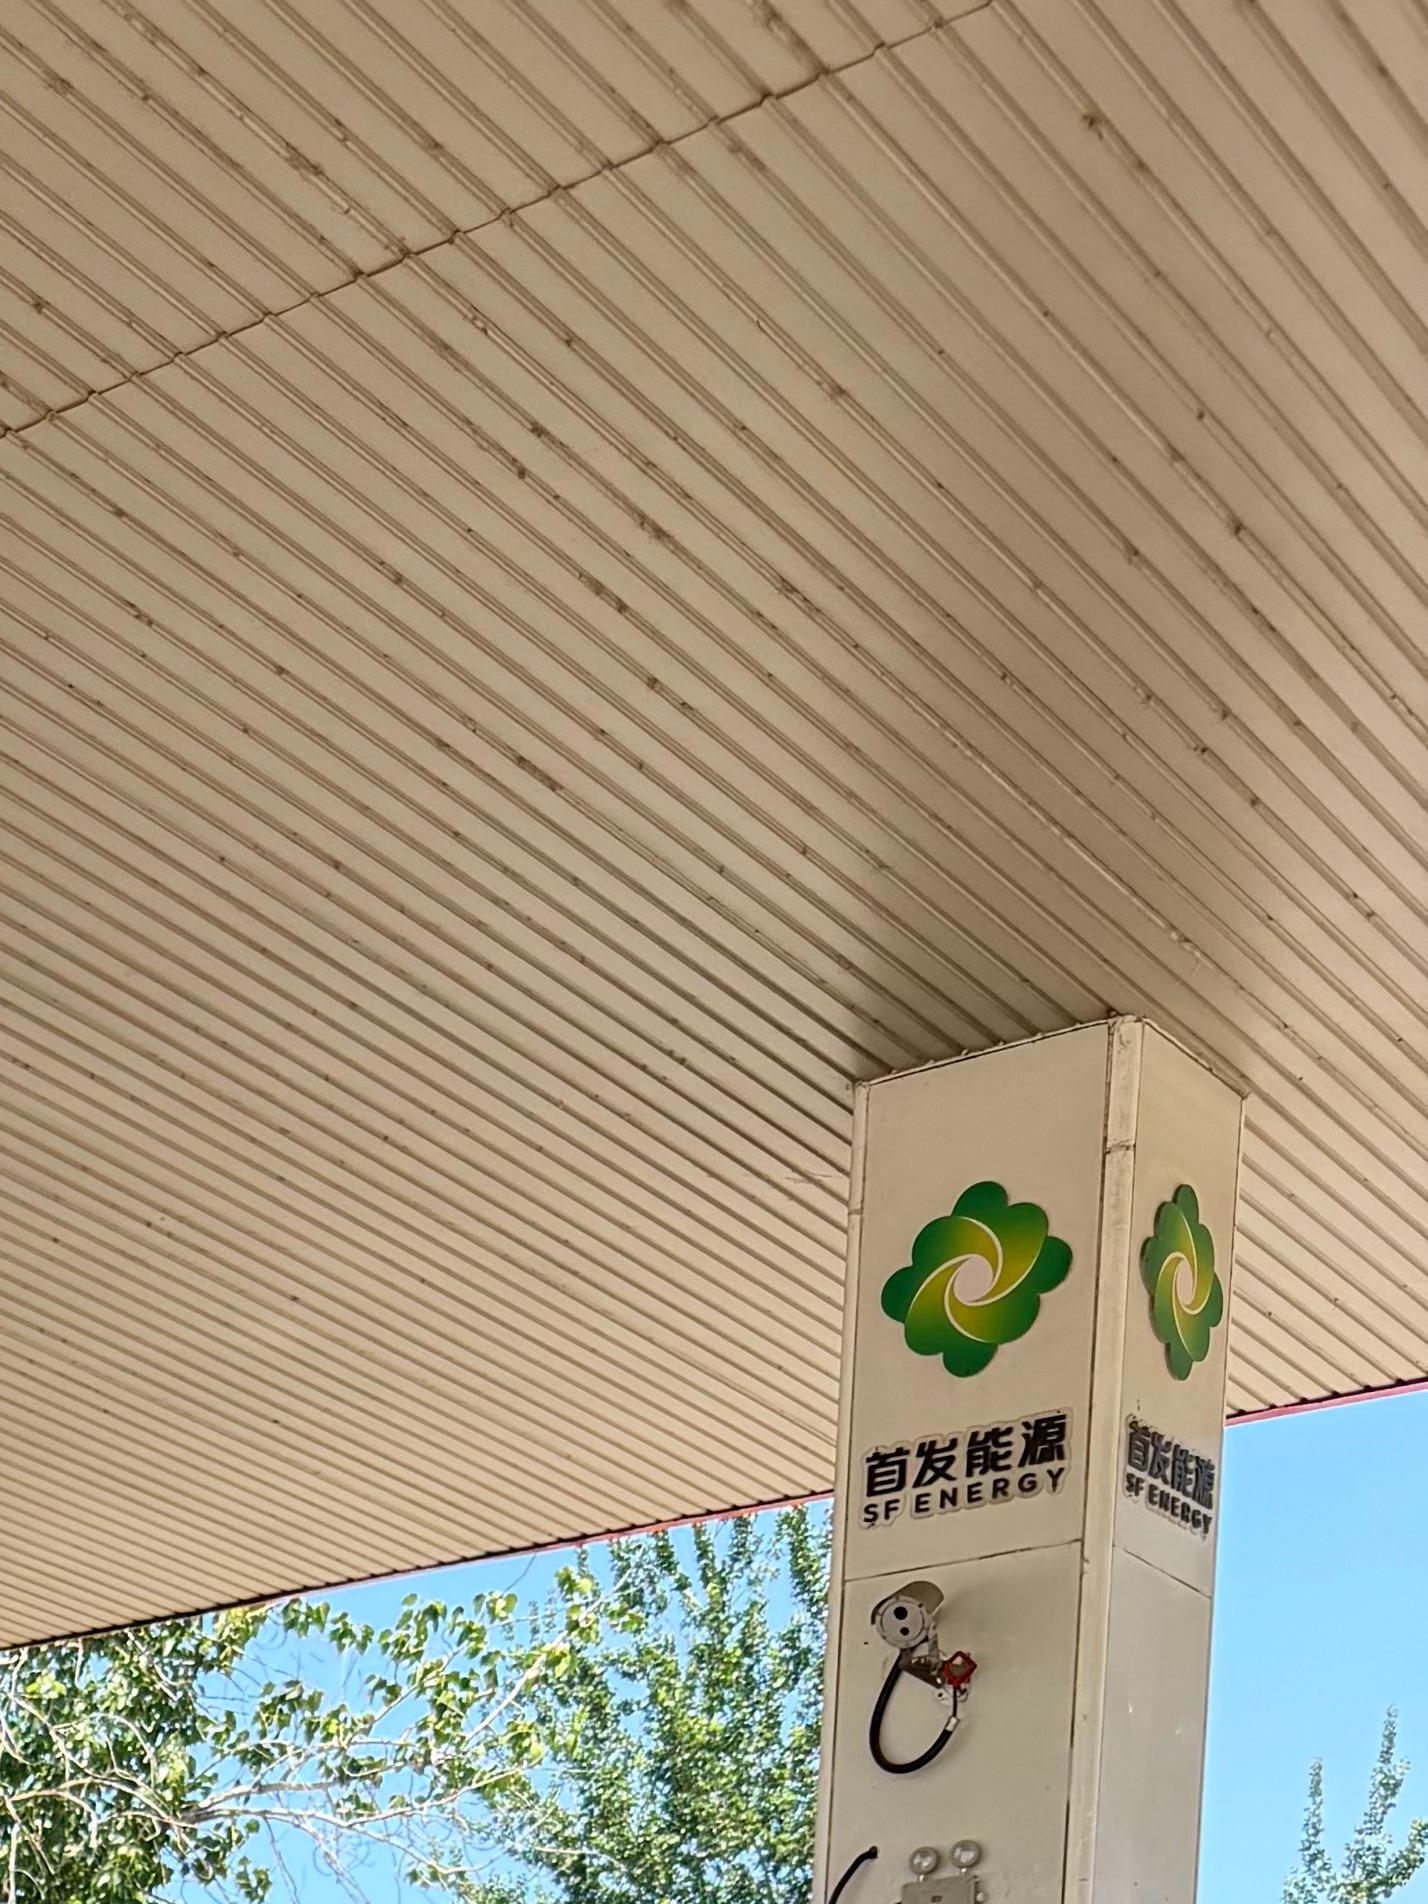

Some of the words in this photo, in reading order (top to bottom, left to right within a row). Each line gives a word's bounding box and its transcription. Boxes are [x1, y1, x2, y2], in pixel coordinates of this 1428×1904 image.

[866, 1412, 1068, 1499] 首发能源
[1127, 1428, 1215, 1510] 首发能源
[863, 1498, 900, 1525] SF
[914, 1466, 1066, 1514] ENERGY
[1125, 1472, 1145, 1498] SF
[1148, 1483, 1213, 1538] ENERGY
